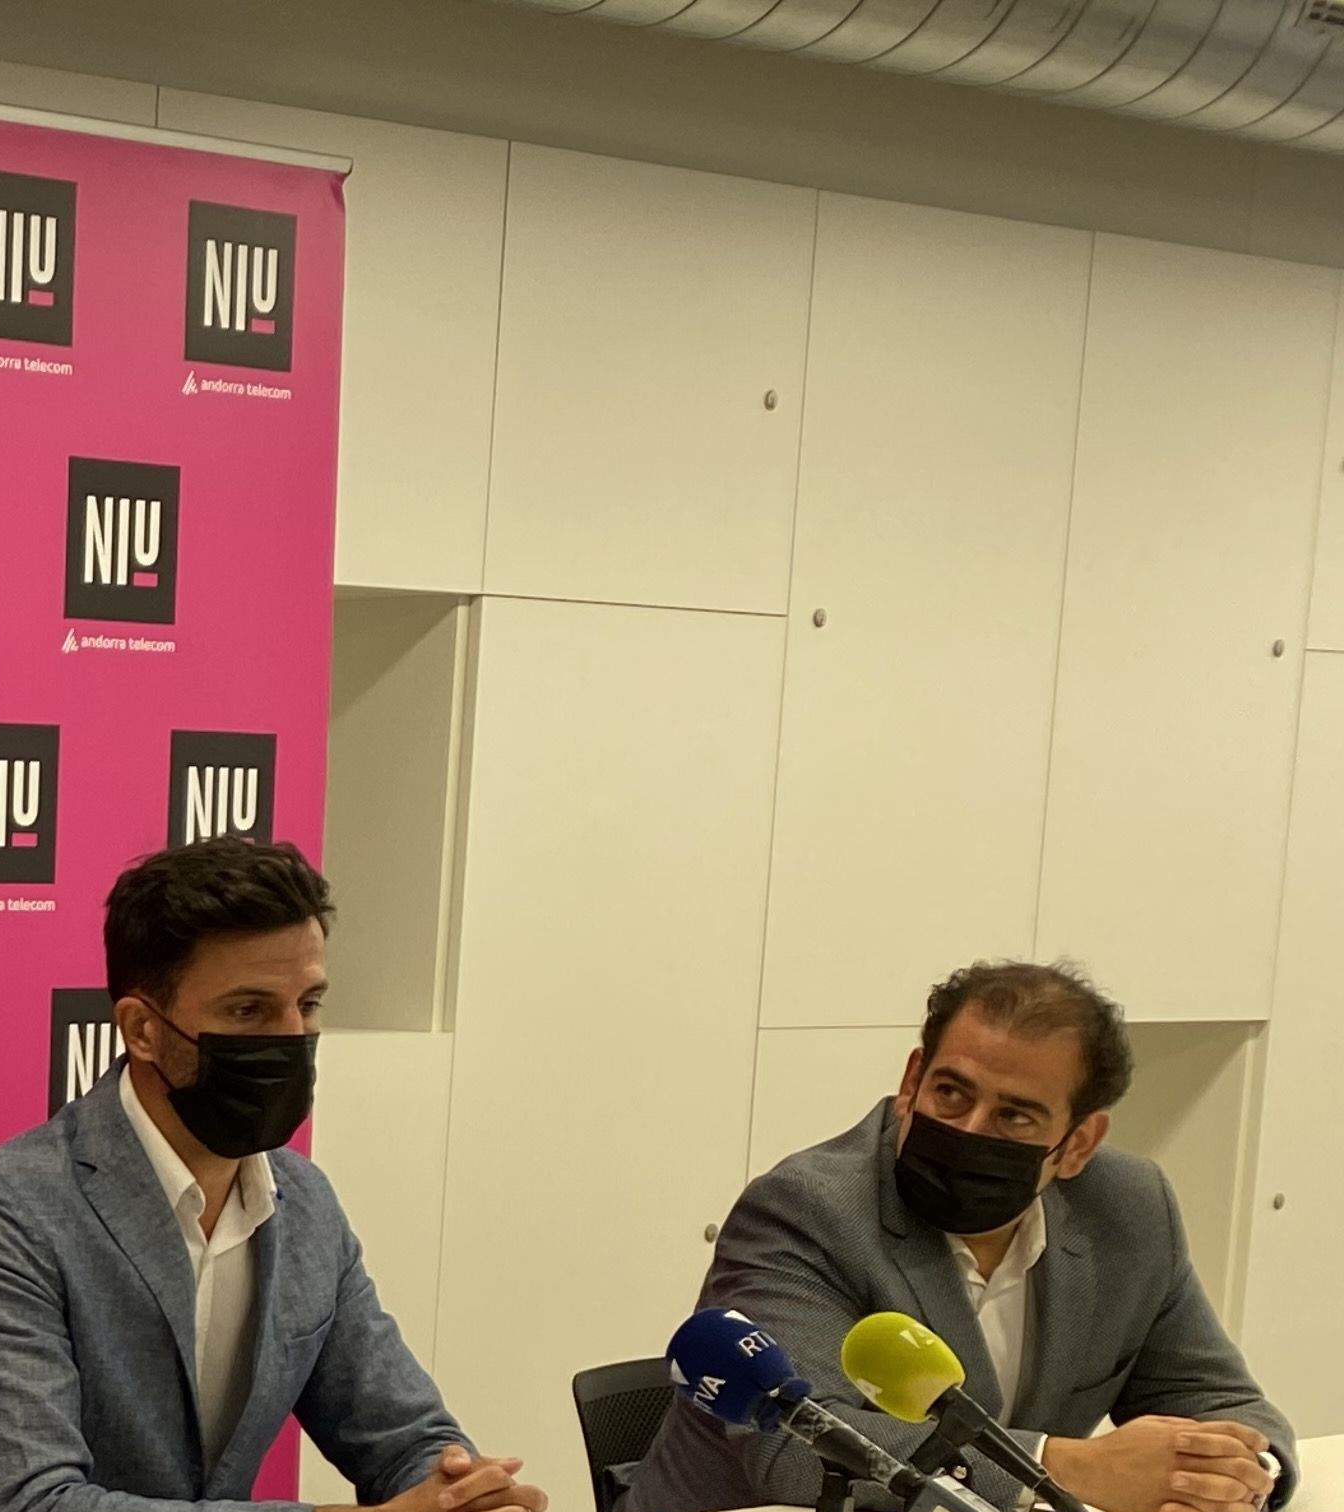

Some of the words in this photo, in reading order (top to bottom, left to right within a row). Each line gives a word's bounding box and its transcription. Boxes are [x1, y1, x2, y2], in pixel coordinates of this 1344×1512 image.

[204, 240, 277, 331] NIU
[23, 357, 73, 376] telecom
[200, 378, 246, 396] andorra
[246, 382, 292, 400] telecom
[84, 496, 160, 585] NIU
[80, 634, 127, 651] andorra
[127, 637, 176, 653] telecom
[186, 766, 257, 846] NIU
[6, 897, 56, 912] telecom
[67, 1023, 126, 1104] NI
